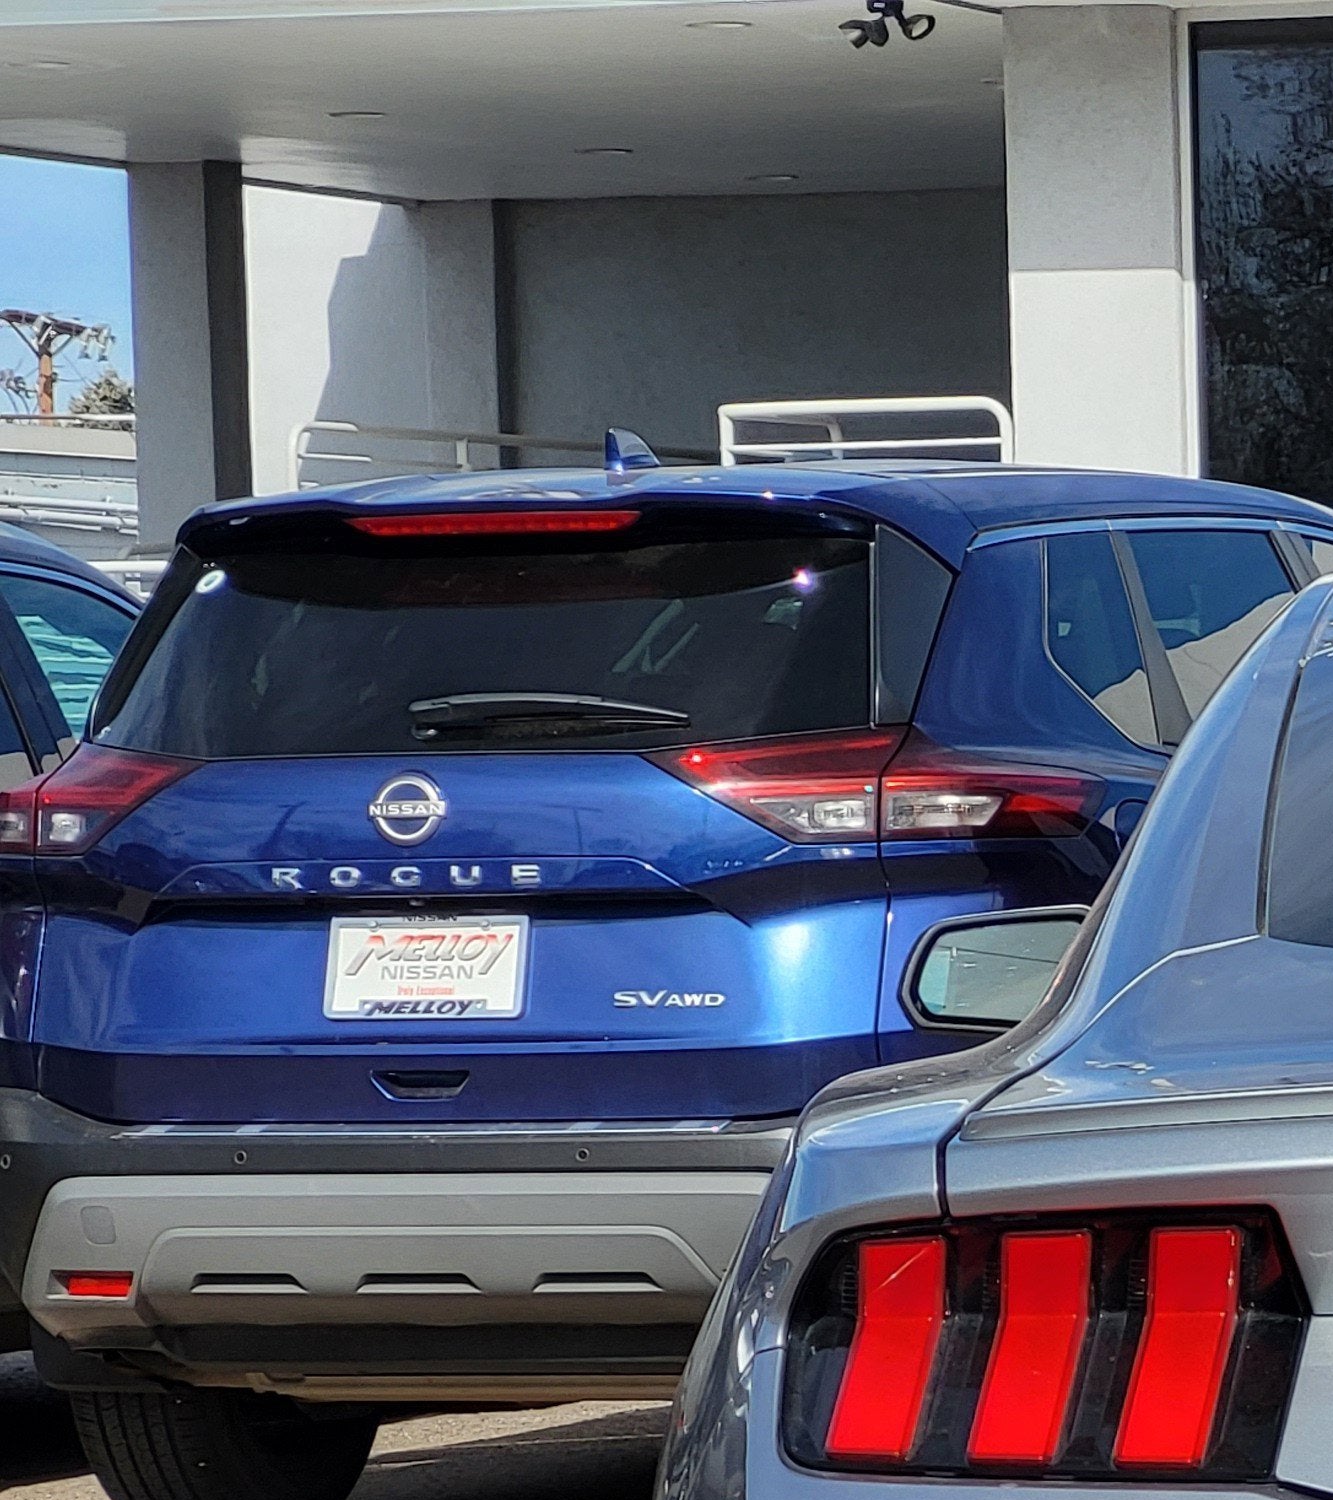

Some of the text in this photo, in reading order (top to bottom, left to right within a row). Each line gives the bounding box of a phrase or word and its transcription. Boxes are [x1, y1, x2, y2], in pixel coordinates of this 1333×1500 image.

[368, 803, 444, 817] NISSAN
[271, 863, 541, 890] ROGUE
[381, 964, 474, 980] NISSAN
[613, 989, 726, 1008] SV AWD
[366, 1000, 474, 1016] MELLOY
